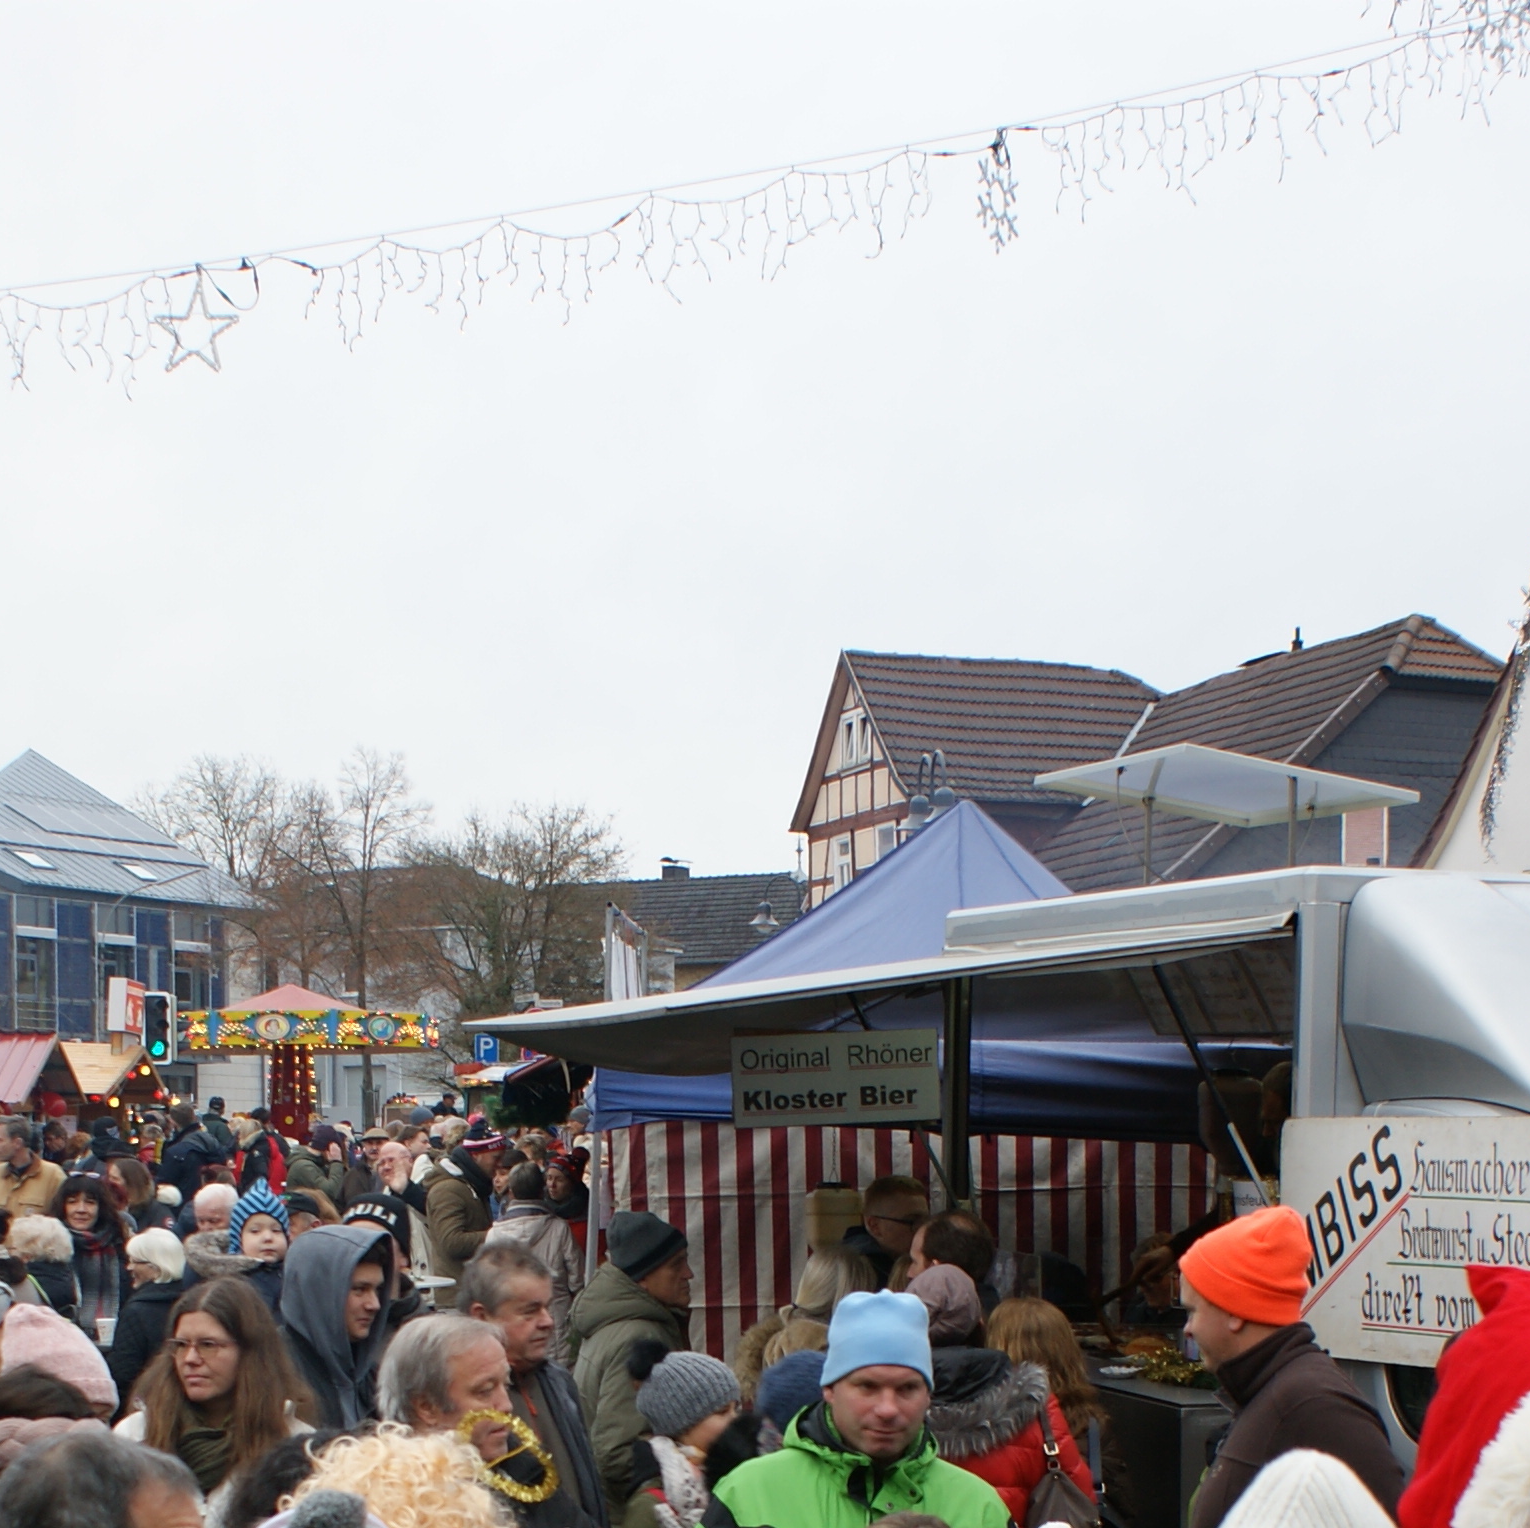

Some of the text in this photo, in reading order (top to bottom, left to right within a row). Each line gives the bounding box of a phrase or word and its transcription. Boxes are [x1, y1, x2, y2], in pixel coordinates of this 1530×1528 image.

[480, 1037, 494, 1058] P
[740, 1043, 932, 1073] Original Rhöner
[743, 1086, 917, 1111] Kloster Bier
[1410, 1140, 1530, 1198] Hausmacher
[1398, 1208, 1473, 1262] Bratwurst
[1362, 1271, 1477, 1329] direkt vom
